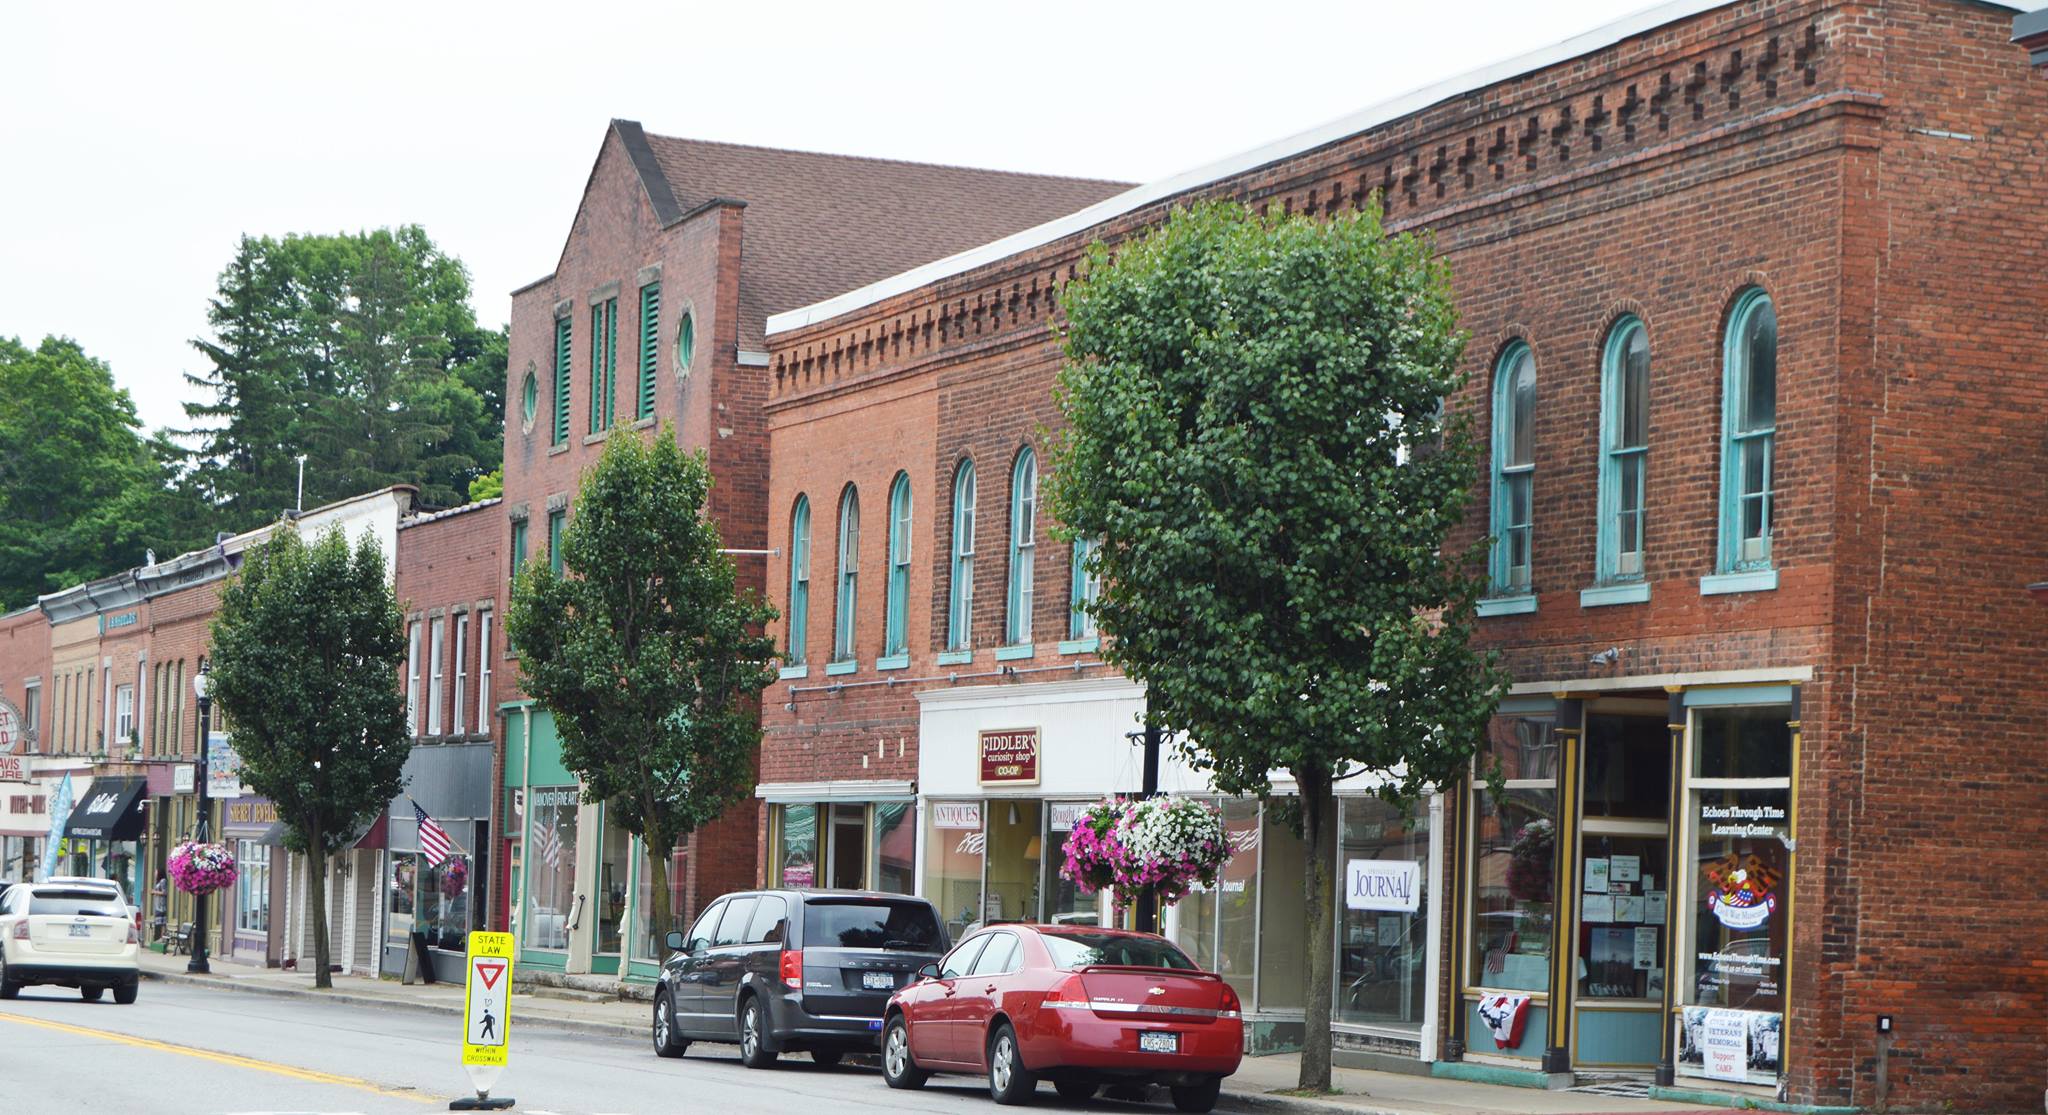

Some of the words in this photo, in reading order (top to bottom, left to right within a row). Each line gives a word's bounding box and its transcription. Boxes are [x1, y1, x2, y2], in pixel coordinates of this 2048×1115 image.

[983, 734, 1036, 757] FIDDLER'S
[988, 752, 1014, 763] curiosity
[1016, 752, 1030, 763] shop
[998, 766, 1018, 776] CO-OP
[936, 806, 978, 825] ANTIQUES
[1053, 806, 1075, 827] Bought
[1702, 806, 1729, 818] Echoes
[1730, 805, 1763, 820] Through
[1763, 806, 1784, 818] Time
[1711, 823, 1746, 838] Learning
[1747, 823, 1774, 835] Center
[1222, 880, 1245, 892] Journal
[1354, 869, 1410, 898] JOURNAL
[478, 936, 506, 944] STATE
[481, 946, 500, 954] LAW
[484, 998, 493, 1006] TO
[1708, 1028, 1743, 1037] VETERANS
[1708, 1038, 1742, 1048] MEMORIAL
[466, 1055, 502, 1063] CROSSWALK
[1712, 1051, 1735, 1062] Support
